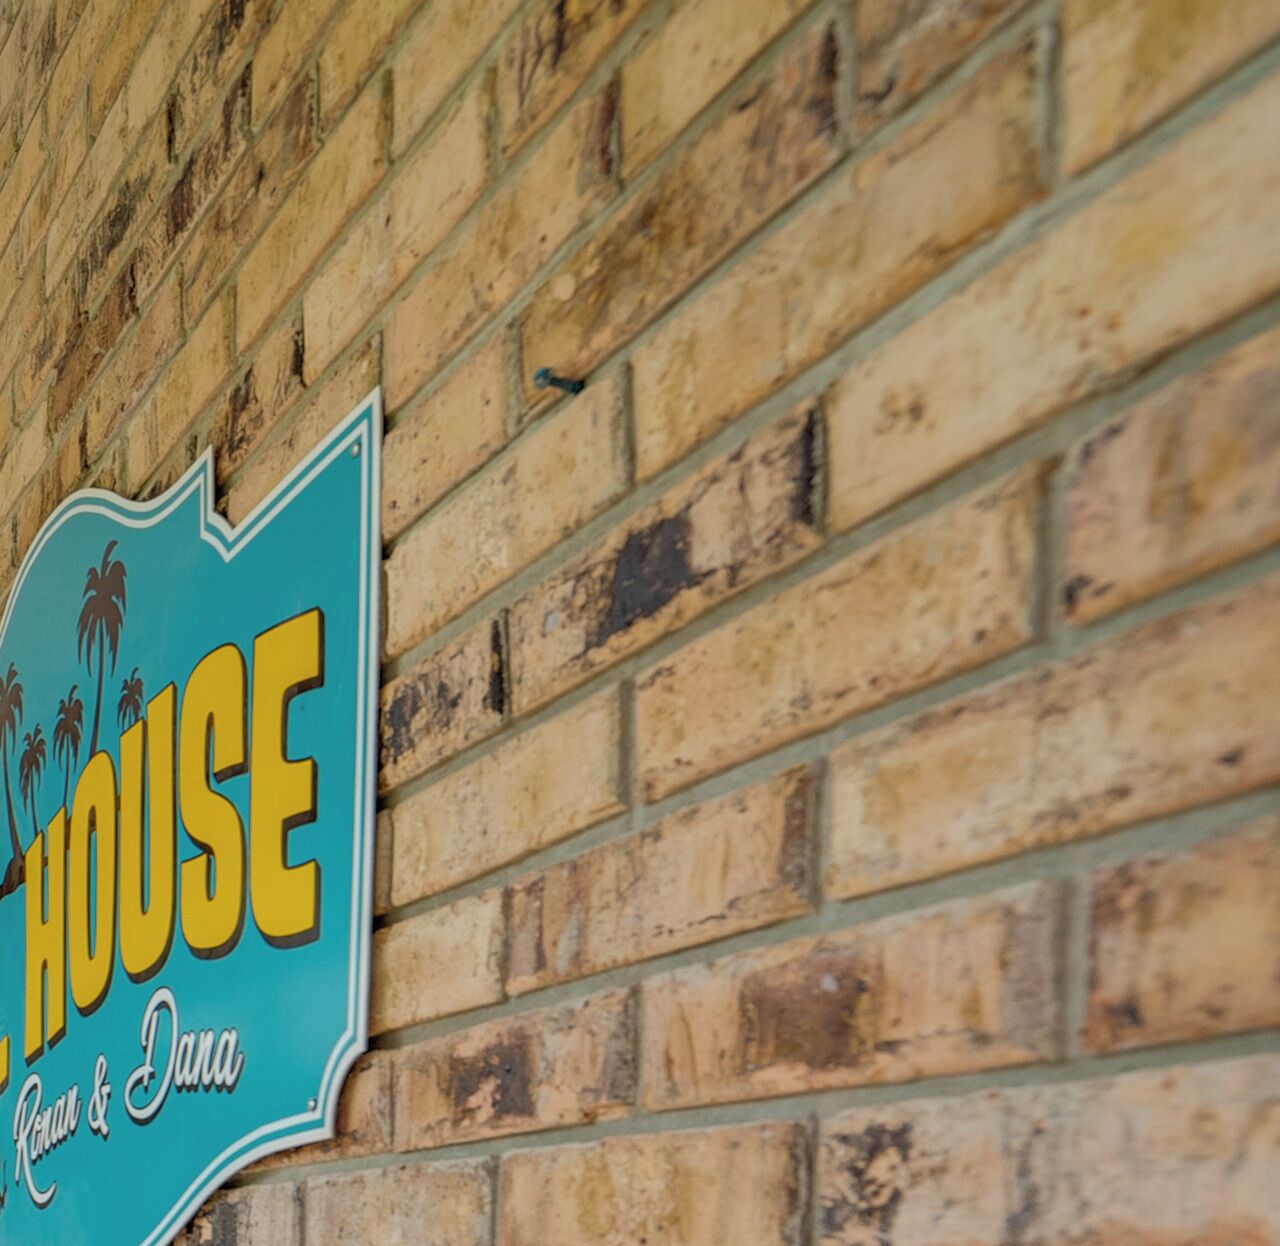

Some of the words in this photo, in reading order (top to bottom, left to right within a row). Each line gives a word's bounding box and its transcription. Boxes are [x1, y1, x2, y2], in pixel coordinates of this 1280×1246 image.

[24, 606, 324, 1066] HOUSE
[87, 1053, 111, 1141] &
[124, 986, 245, 1126] Dana
